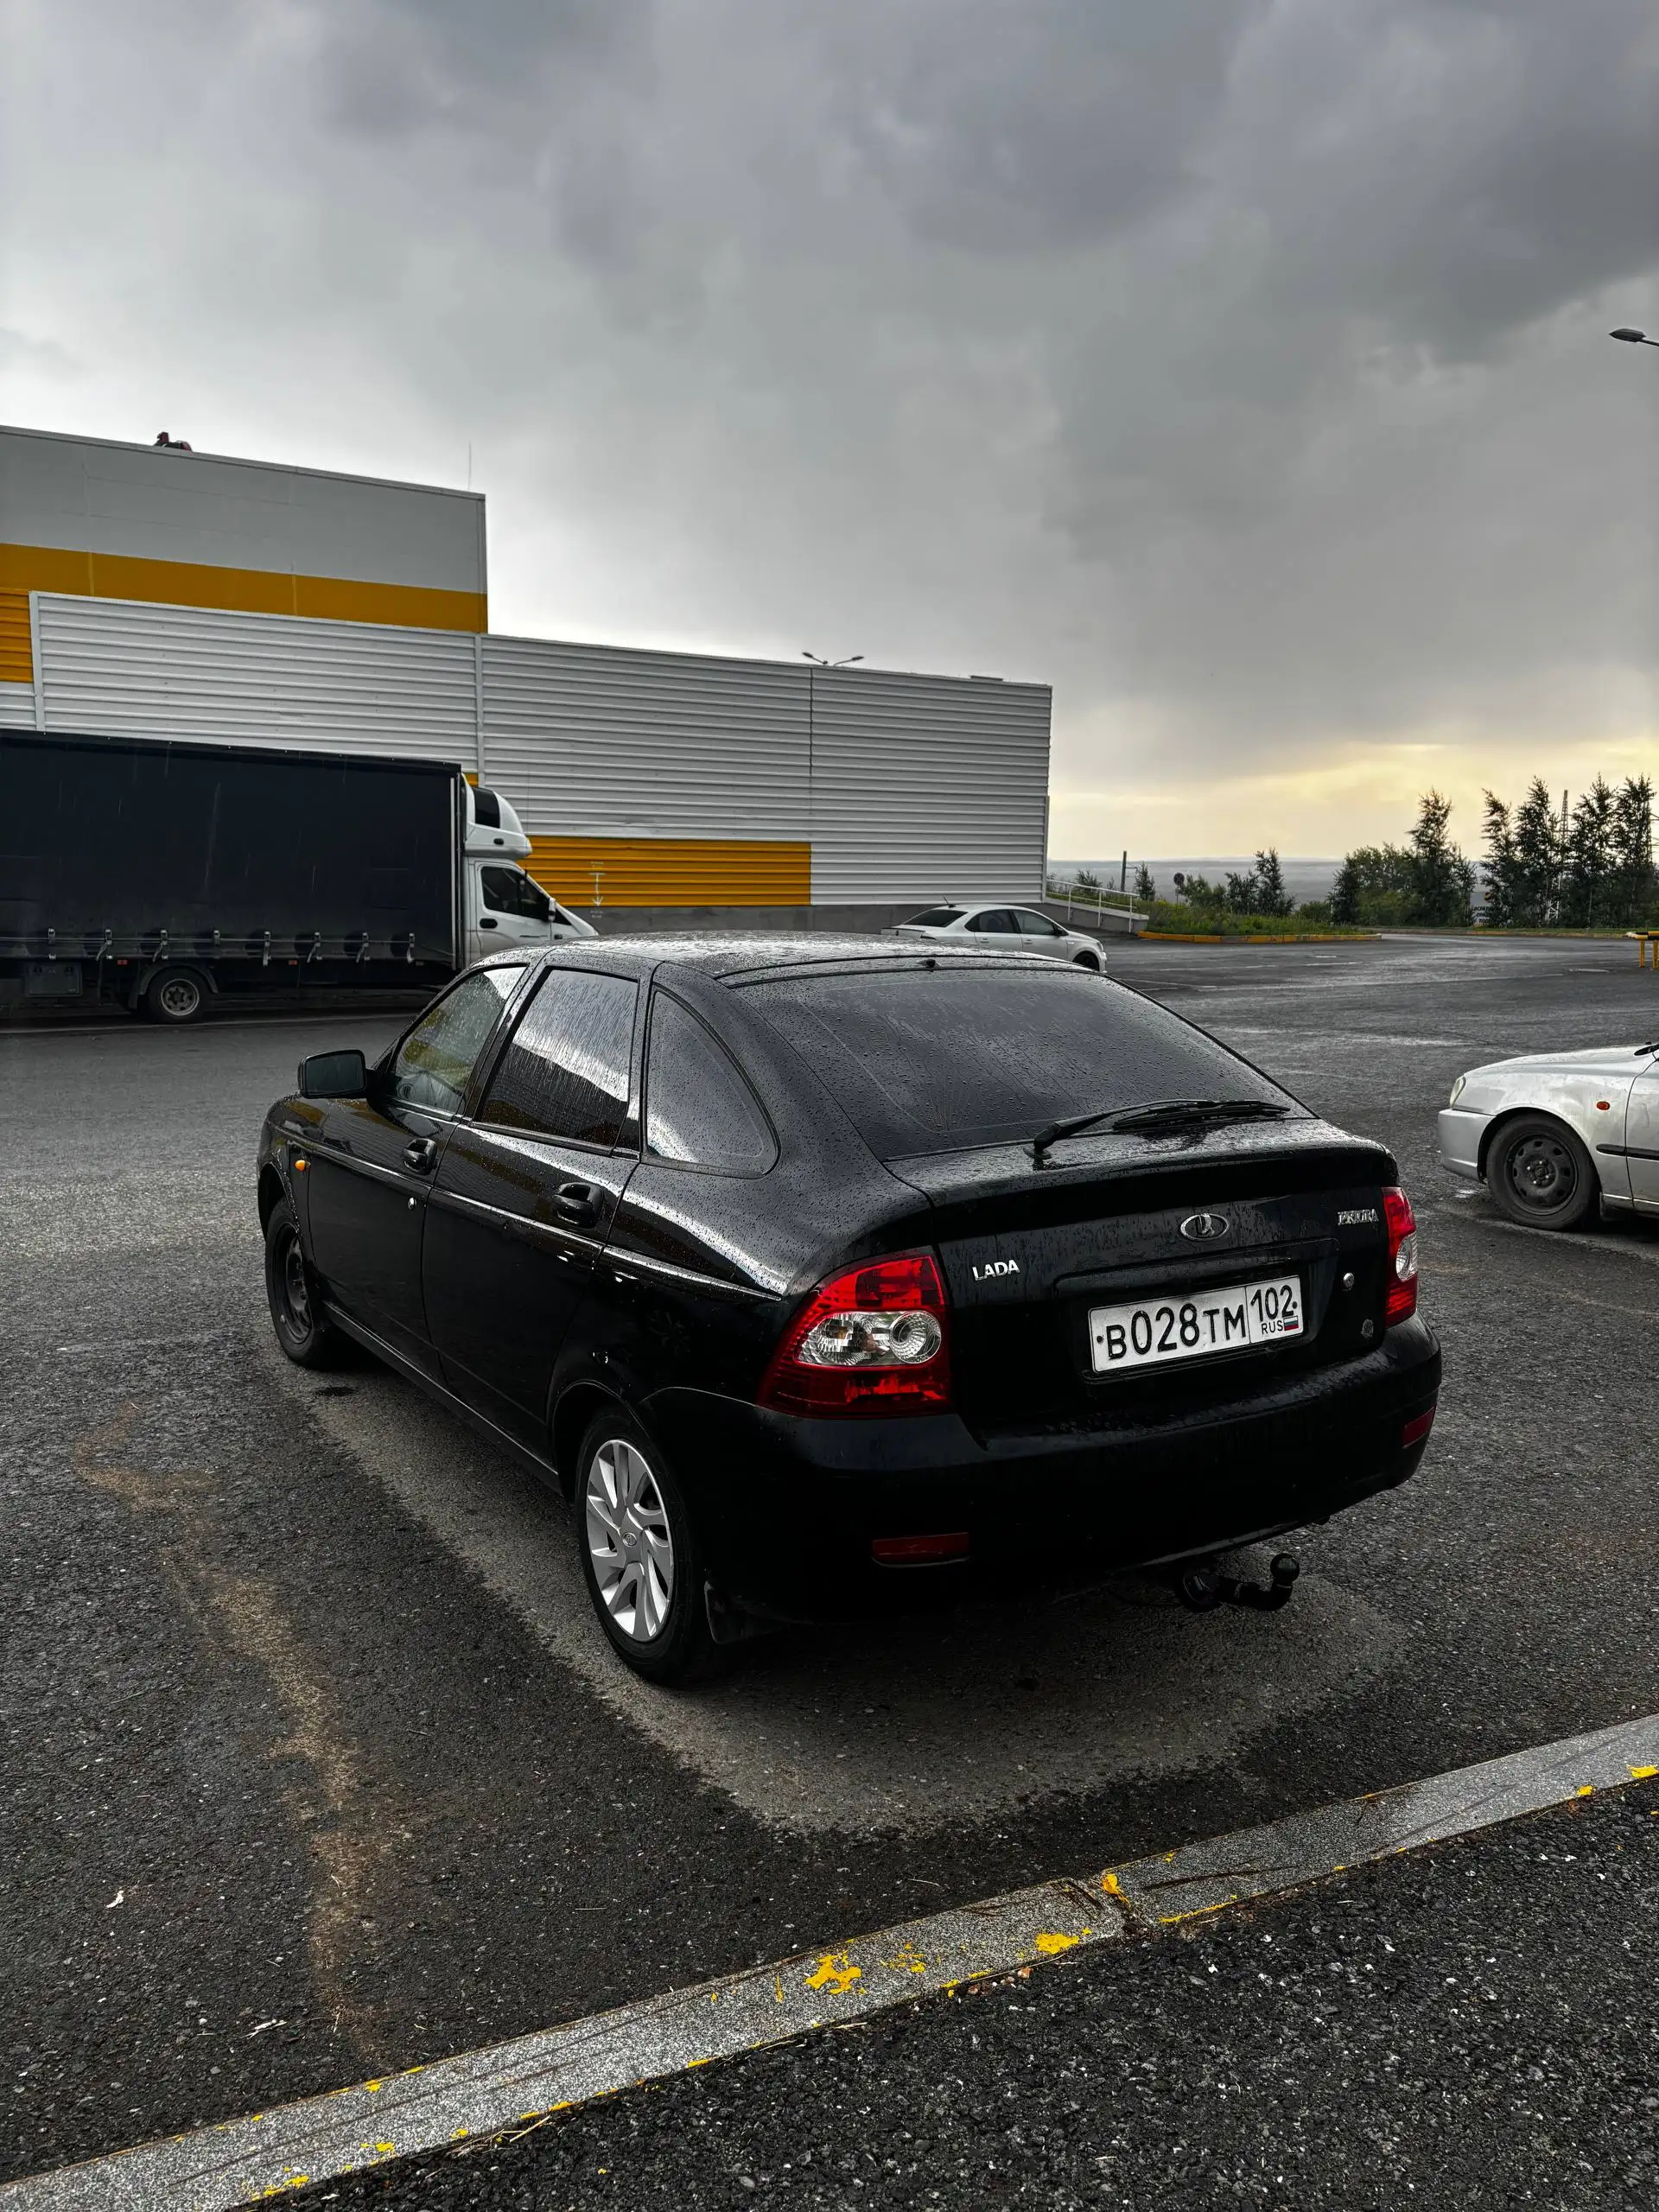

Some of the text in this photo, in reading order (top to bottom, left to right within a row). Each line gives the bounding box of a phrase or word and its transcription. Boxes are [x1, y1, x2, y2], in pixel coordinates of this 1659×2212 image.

[972, 1259, 1020, 1281] LADA
[1250, 1285, 1294, 1322] 102
[1262, 1319, 1283, 1335] RUS
